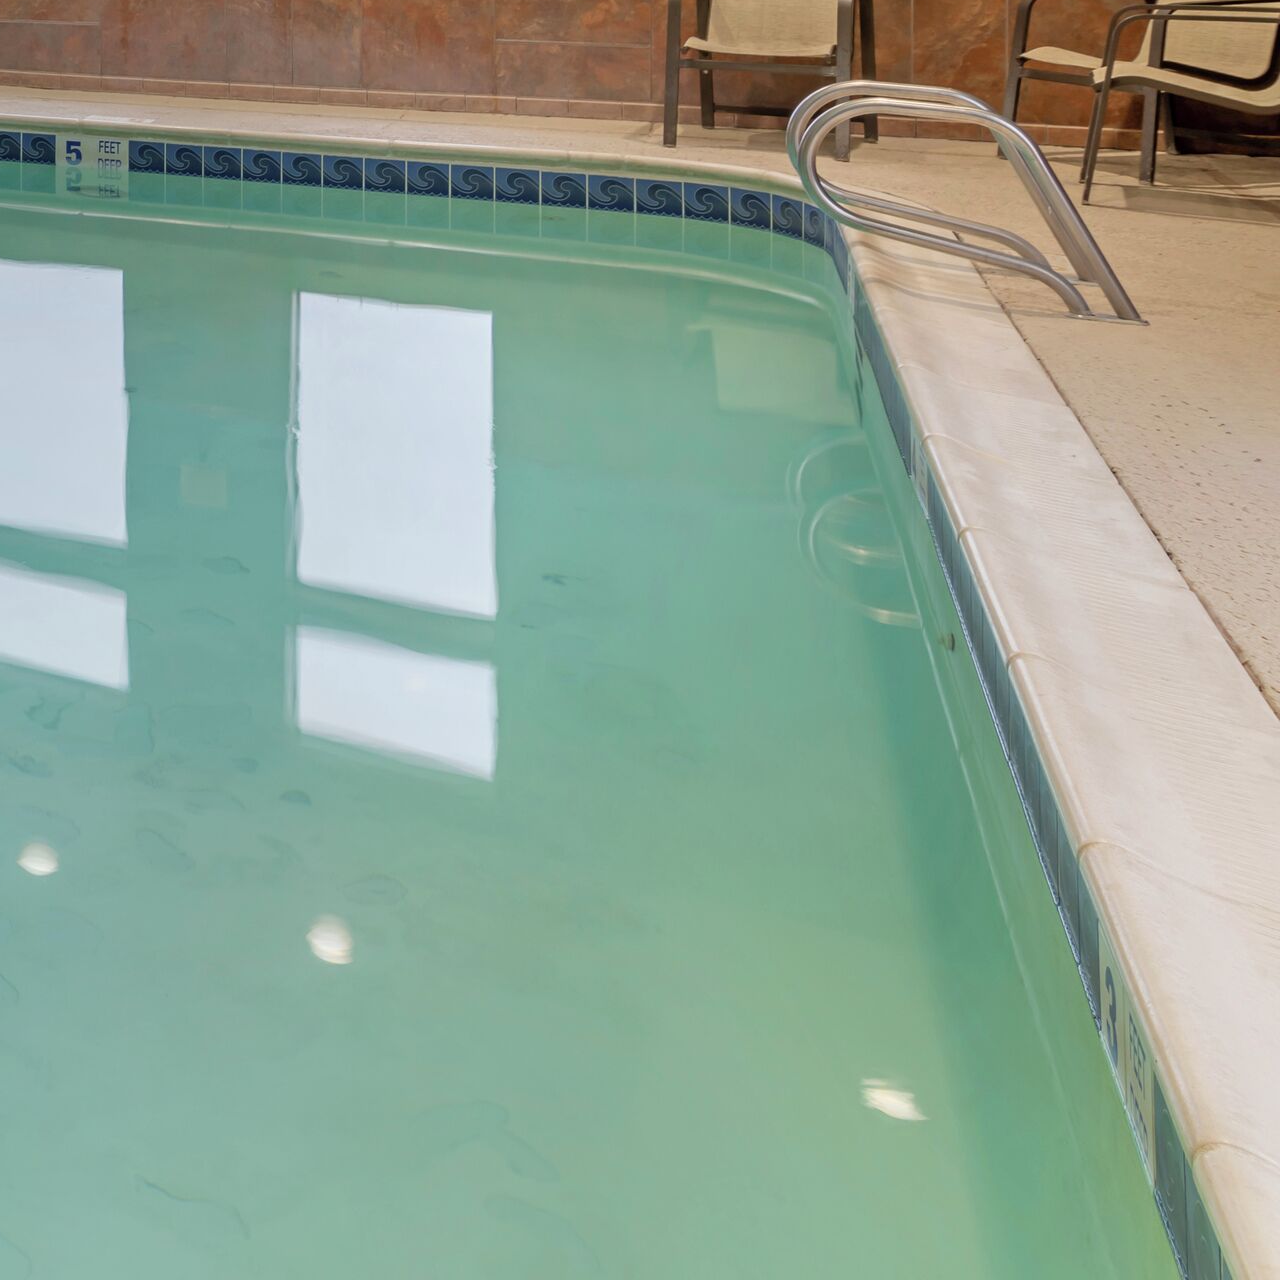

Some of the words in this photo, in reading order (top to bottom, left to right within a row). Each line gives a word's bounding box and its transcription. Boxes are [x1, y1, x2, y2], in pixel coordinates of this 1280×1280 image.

[65, 140, 82, 165] 5
[99, 140, 121, 154] FEET
[1105, 966, 1118, 1068] 3
